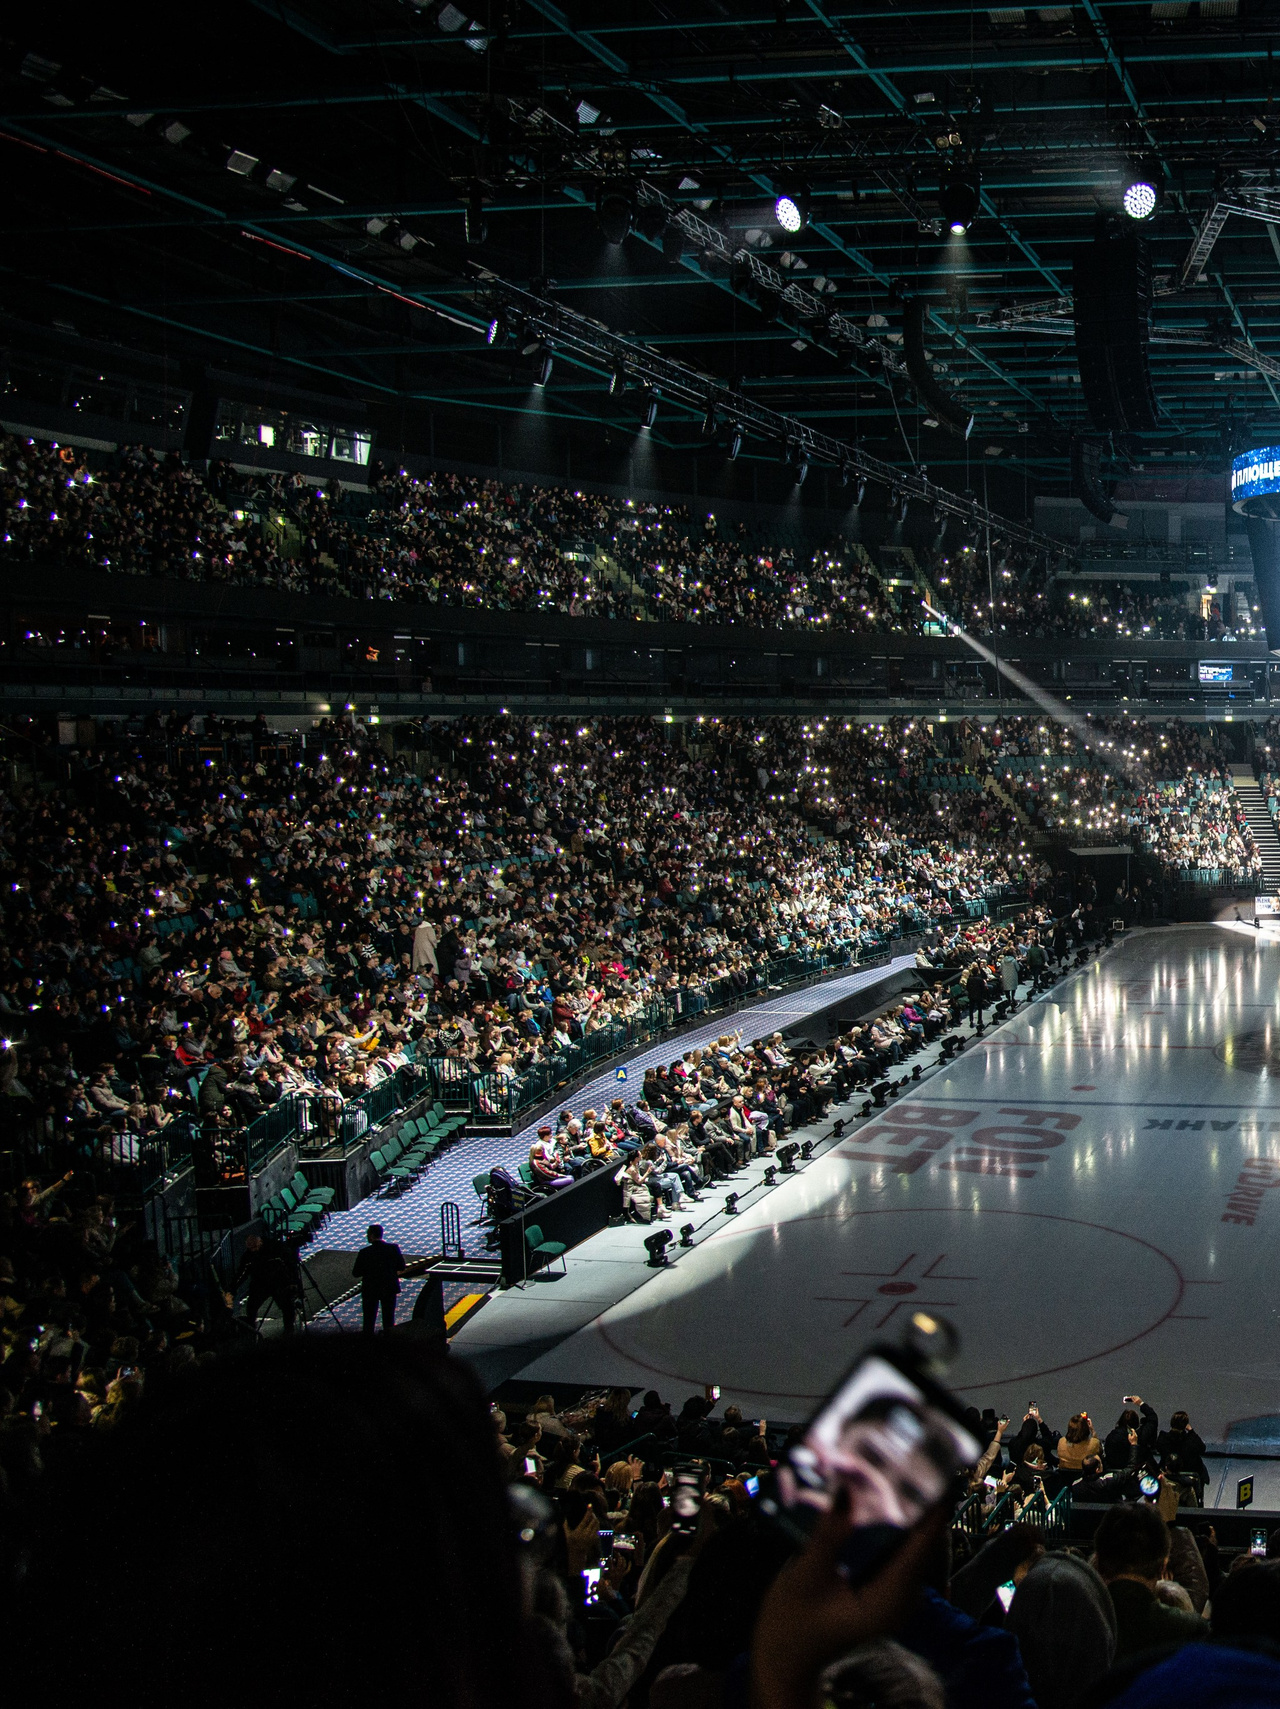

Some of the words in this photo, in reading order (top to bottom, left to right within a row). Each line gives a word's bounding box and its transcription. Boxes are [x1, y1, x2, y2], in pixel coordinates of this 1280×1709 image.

[825, 1104, 981, 1174] BET
[938, 1107, 1082, 1178] FON
[1240, 1483, 1252, 1502] B
